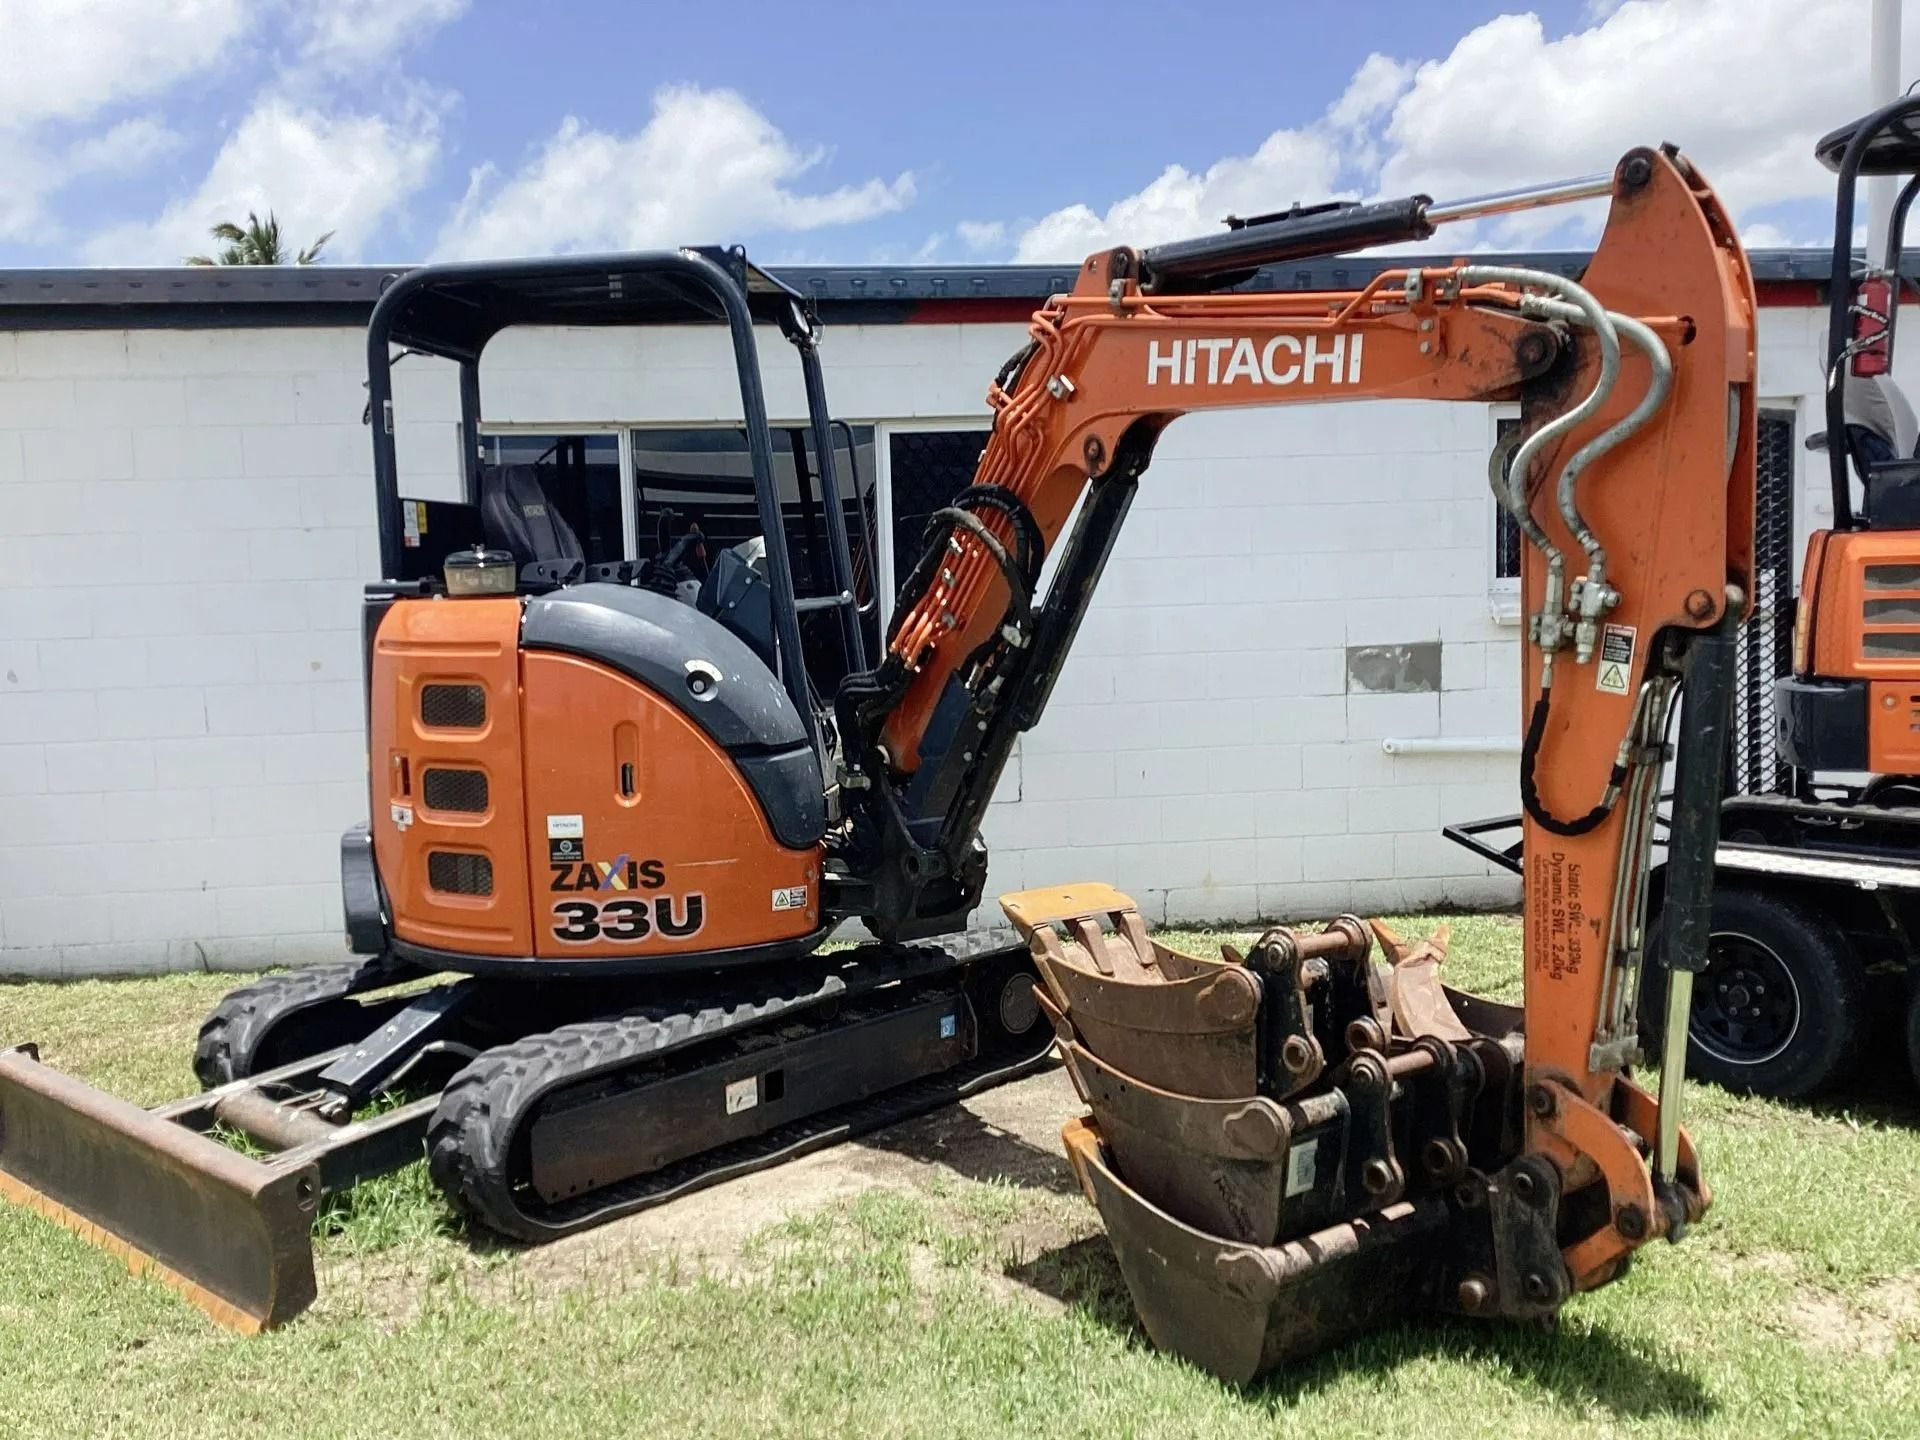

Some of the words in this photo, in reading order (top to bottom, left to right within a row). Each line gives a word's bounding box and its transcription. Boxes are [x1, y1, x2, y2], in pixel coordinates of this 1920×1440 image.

[1148, 333, 1364, 386] HITACHI
[550, 853, 666, 892] ZAXIS
[1549, 852, 1565, 905] Dynamic
[1568, 863, 1582, 898] Static
[551, 893, 705, 943] 33U
